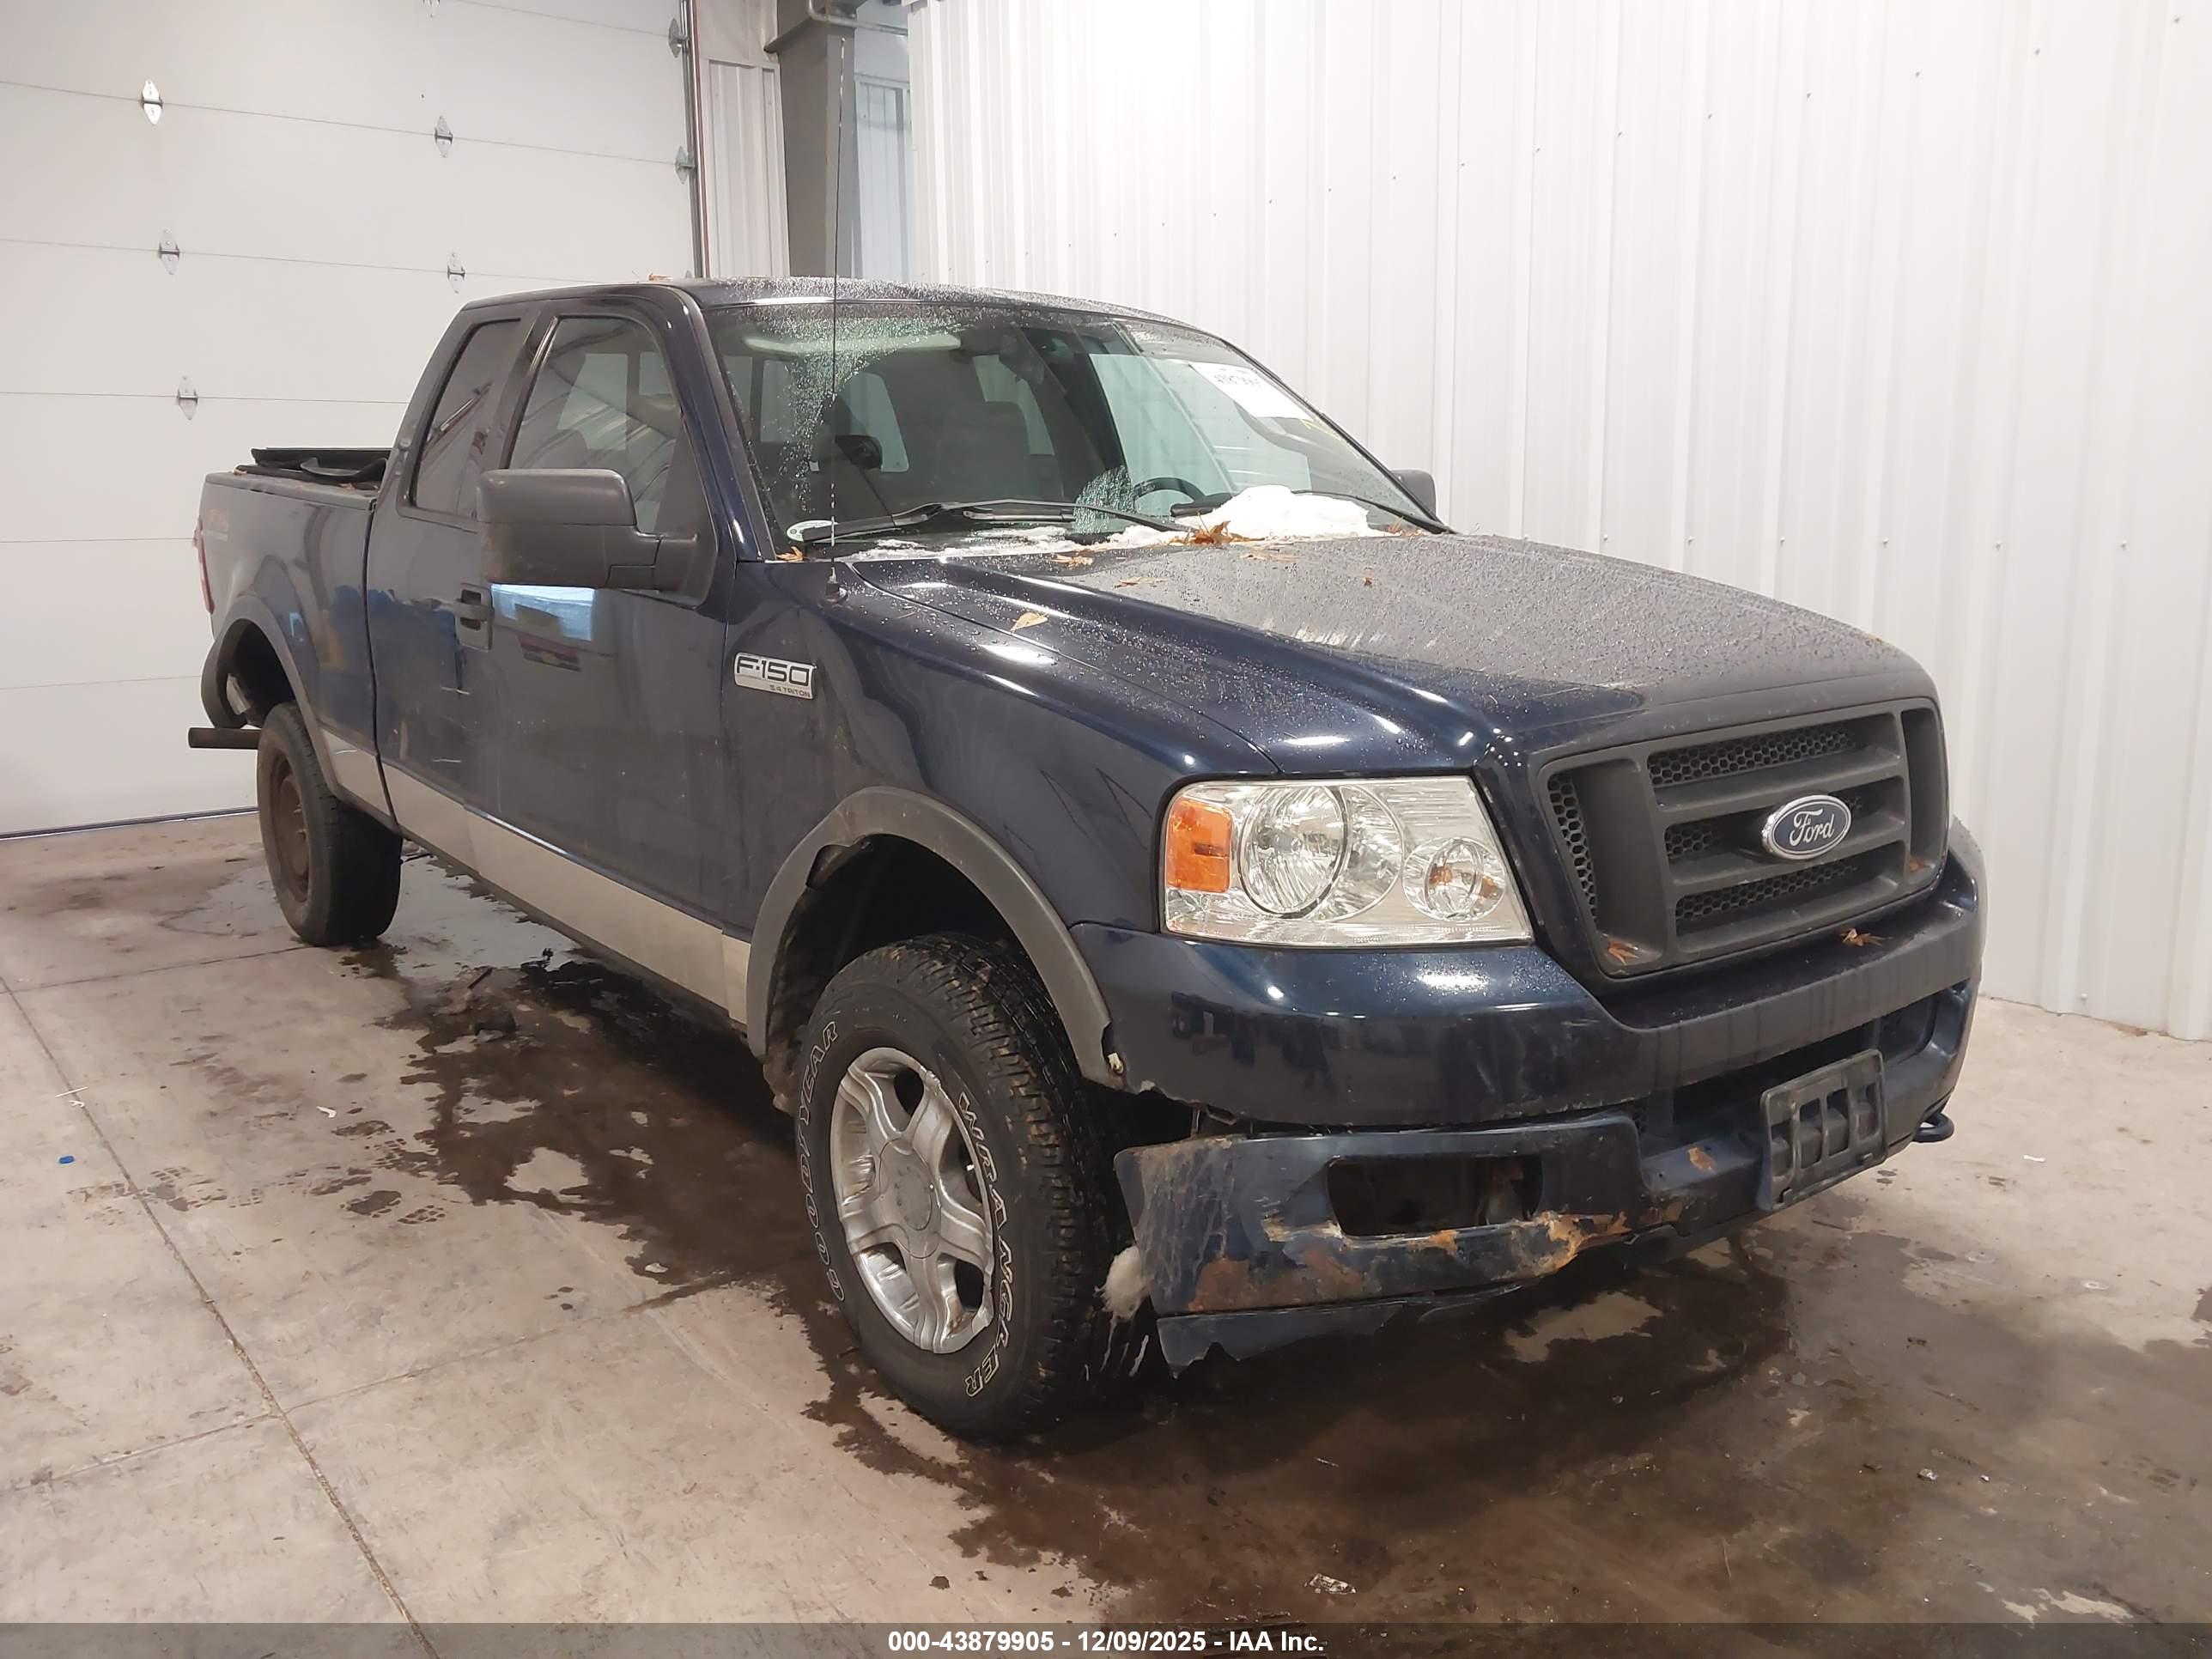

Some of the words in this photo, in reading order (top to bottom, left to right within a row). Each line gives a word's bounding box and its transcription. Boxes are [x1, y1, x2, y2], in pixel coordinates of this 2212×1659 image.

[1789, 808, 1835, 847] Ford
[798, 1020, 845, 1302] GOODYEAR
[958, 1091, 1013, 1398] WRANGLER
